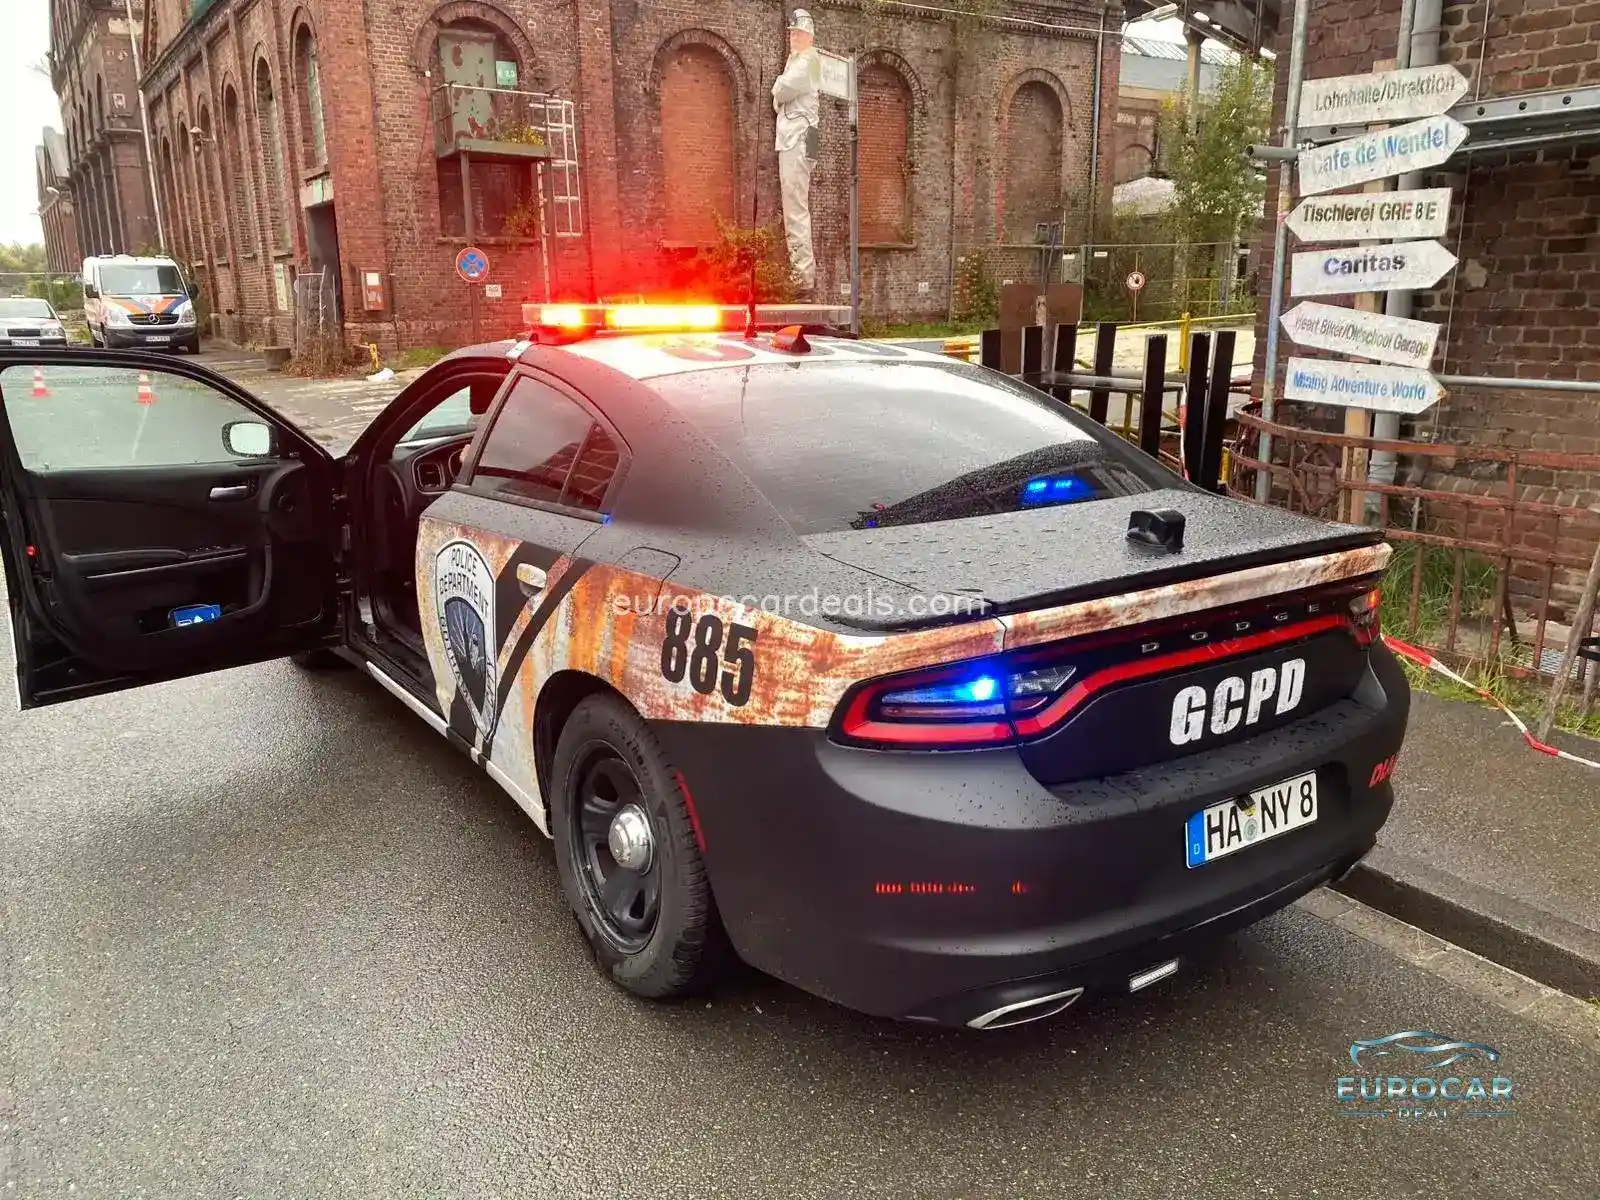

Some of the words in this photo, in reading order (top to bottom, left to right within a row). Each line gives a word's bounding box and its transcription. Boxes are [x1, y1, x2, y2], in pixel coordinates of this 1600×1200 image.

[1355, 142, 1377, 164] de
[1382, 122, 1450, 157] Wendel
[1303, 202, 1375, 222] Tischlerei
[1323, 254, 1406, 276] Caritas
[1393, 334, 1428, 358] Garage
[1293, 370, 1328, 394] Mining
[1330, 374, 1388, 395] Adventure
[1391, 380, 1426, 400] World
[450, 548, 478, 577] POLICE
[439, 572, 489, 619] DEPARTMENT
[1141, 603, 1320, 653] DODGE
[661, 605, 758, 707] 885
[1169, 658, 1306, 745] GCPD
[1206, 805, 1243, 853] HA
[1260, 785, 1292, 833] NY
[1299, 779, 1313, 818] 8
